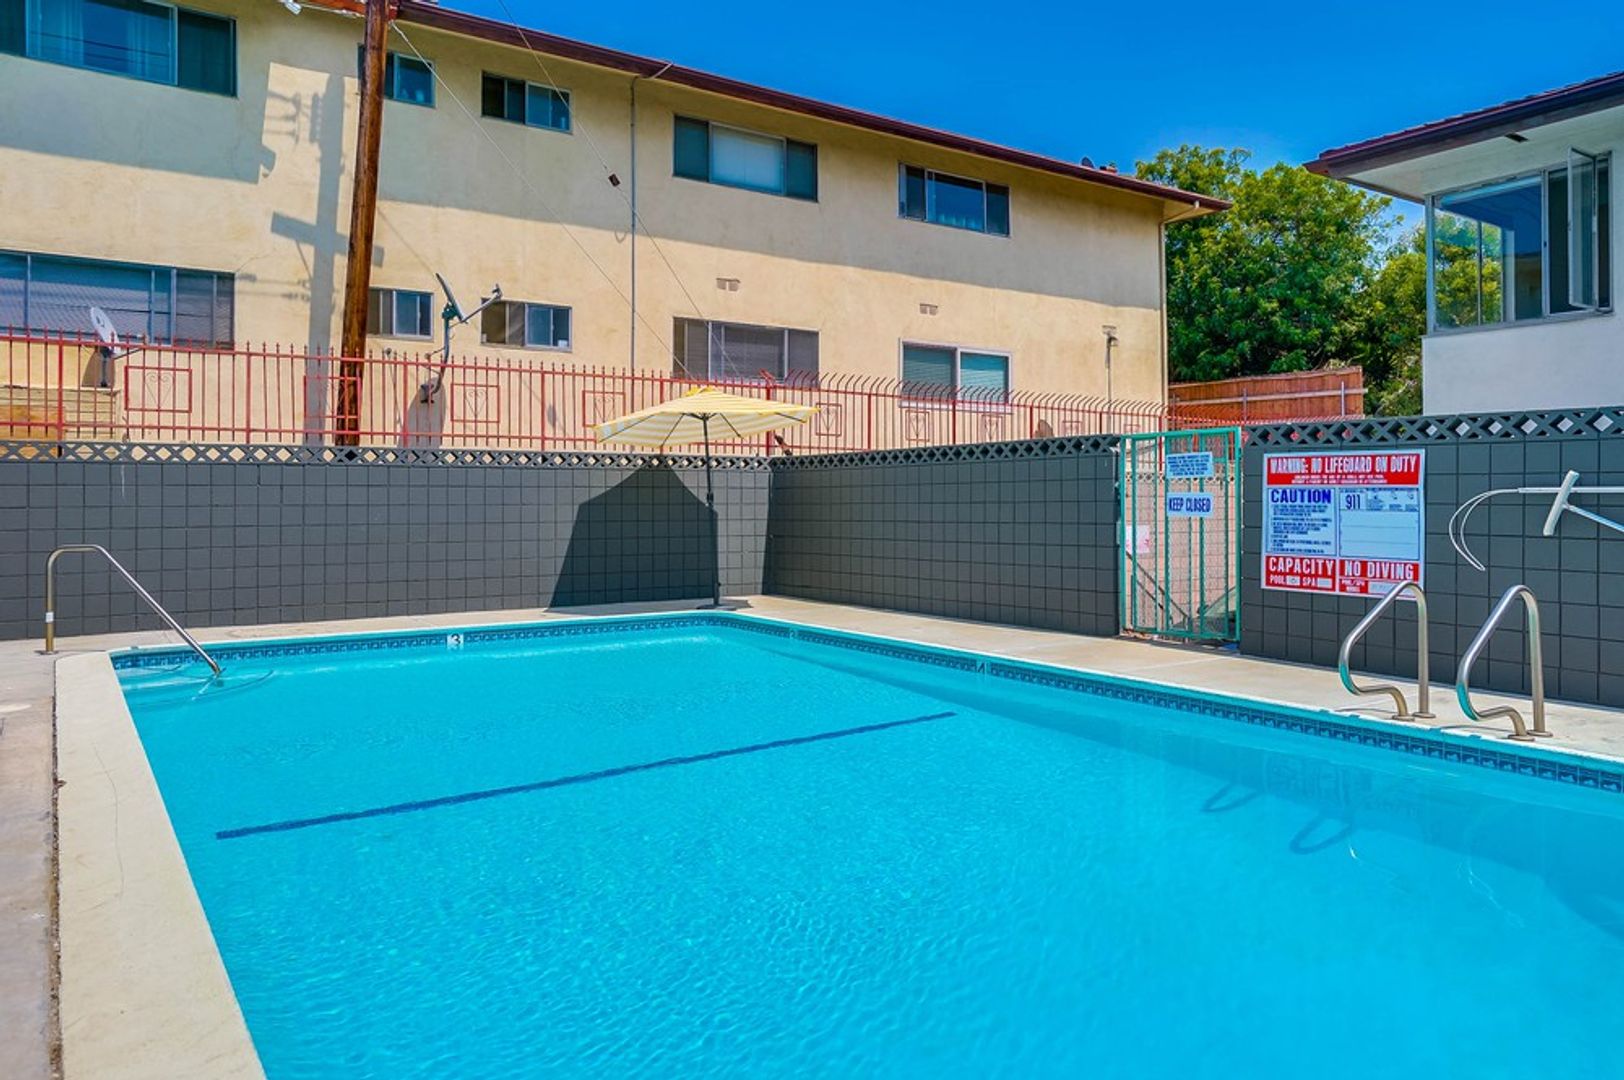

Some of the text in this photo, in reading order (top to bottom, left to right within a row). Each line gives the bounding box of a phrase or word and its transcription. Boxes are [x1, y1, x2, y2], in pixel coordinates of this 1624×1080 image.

[1270, 455, 1416, 474] WARNING: NO LIFEGUARD ON DUTY
[1169, 497, 1211, 512] KEEP CLOSED
[1271, 489, 1331, 504] CAUTION
[1345, 494, 1361, 510] 911
[1269, 556, 1334, 576] CAPACITY
[1344, 560, 1414, 580] NO DIVING
[1269, 576, 1316, 586] POOL SPA
